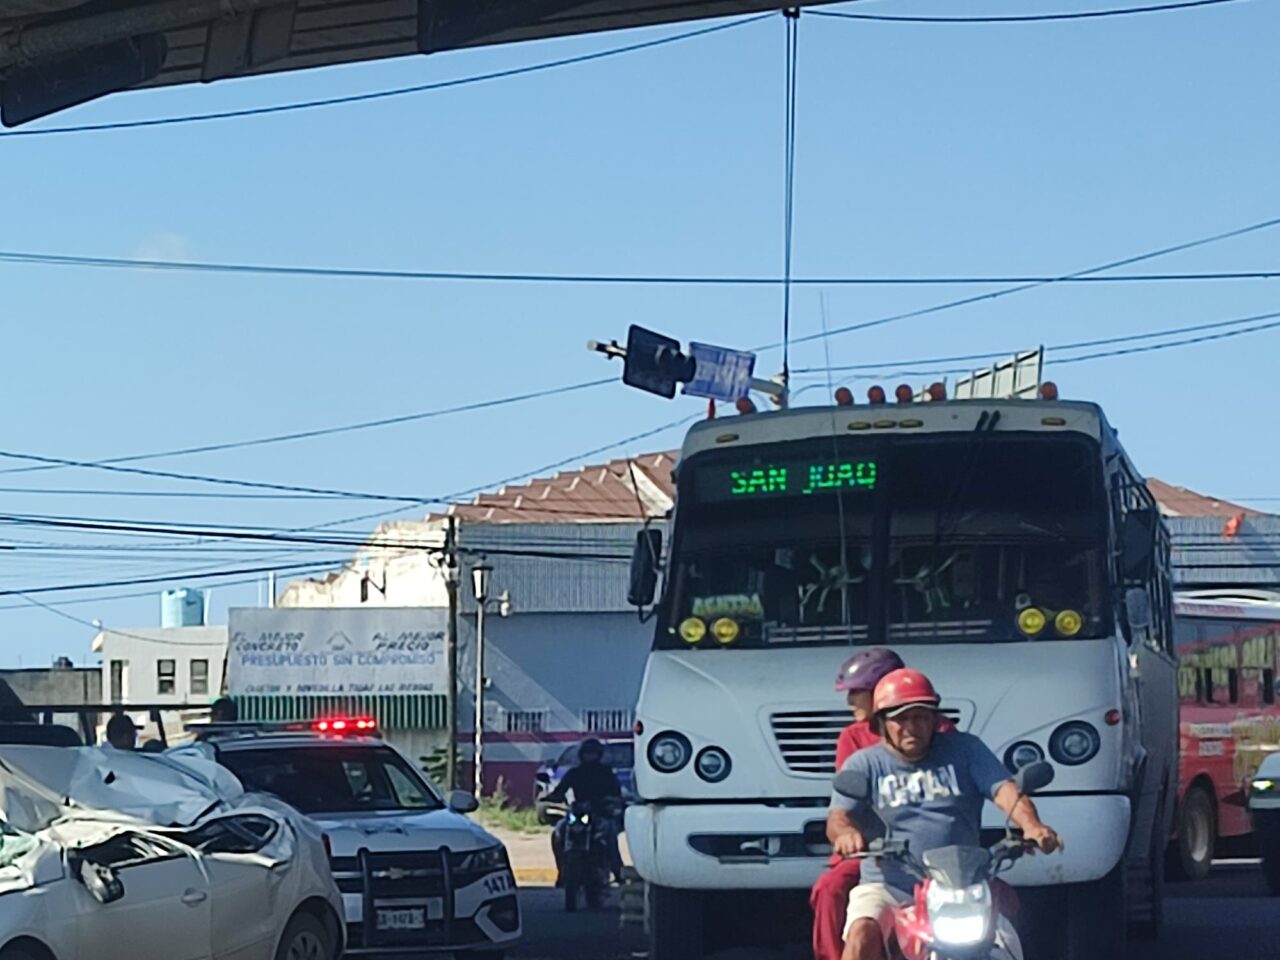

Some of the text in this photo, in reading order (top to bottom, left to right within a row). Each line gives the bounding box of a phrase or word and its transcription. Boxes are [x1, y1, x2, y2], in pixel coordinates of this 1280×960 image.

[731, 468, 786, 494] SAN
[259, 632, 304, 642] MEJOR
[398, 631, 445, 642] MEJOR
[236, 641, 299, 651] CONCRETO
[376, 641, 431, 651] PRECIO
[241, 652, 435, 666] PRESUPUESTO SIN COMPROMISO
